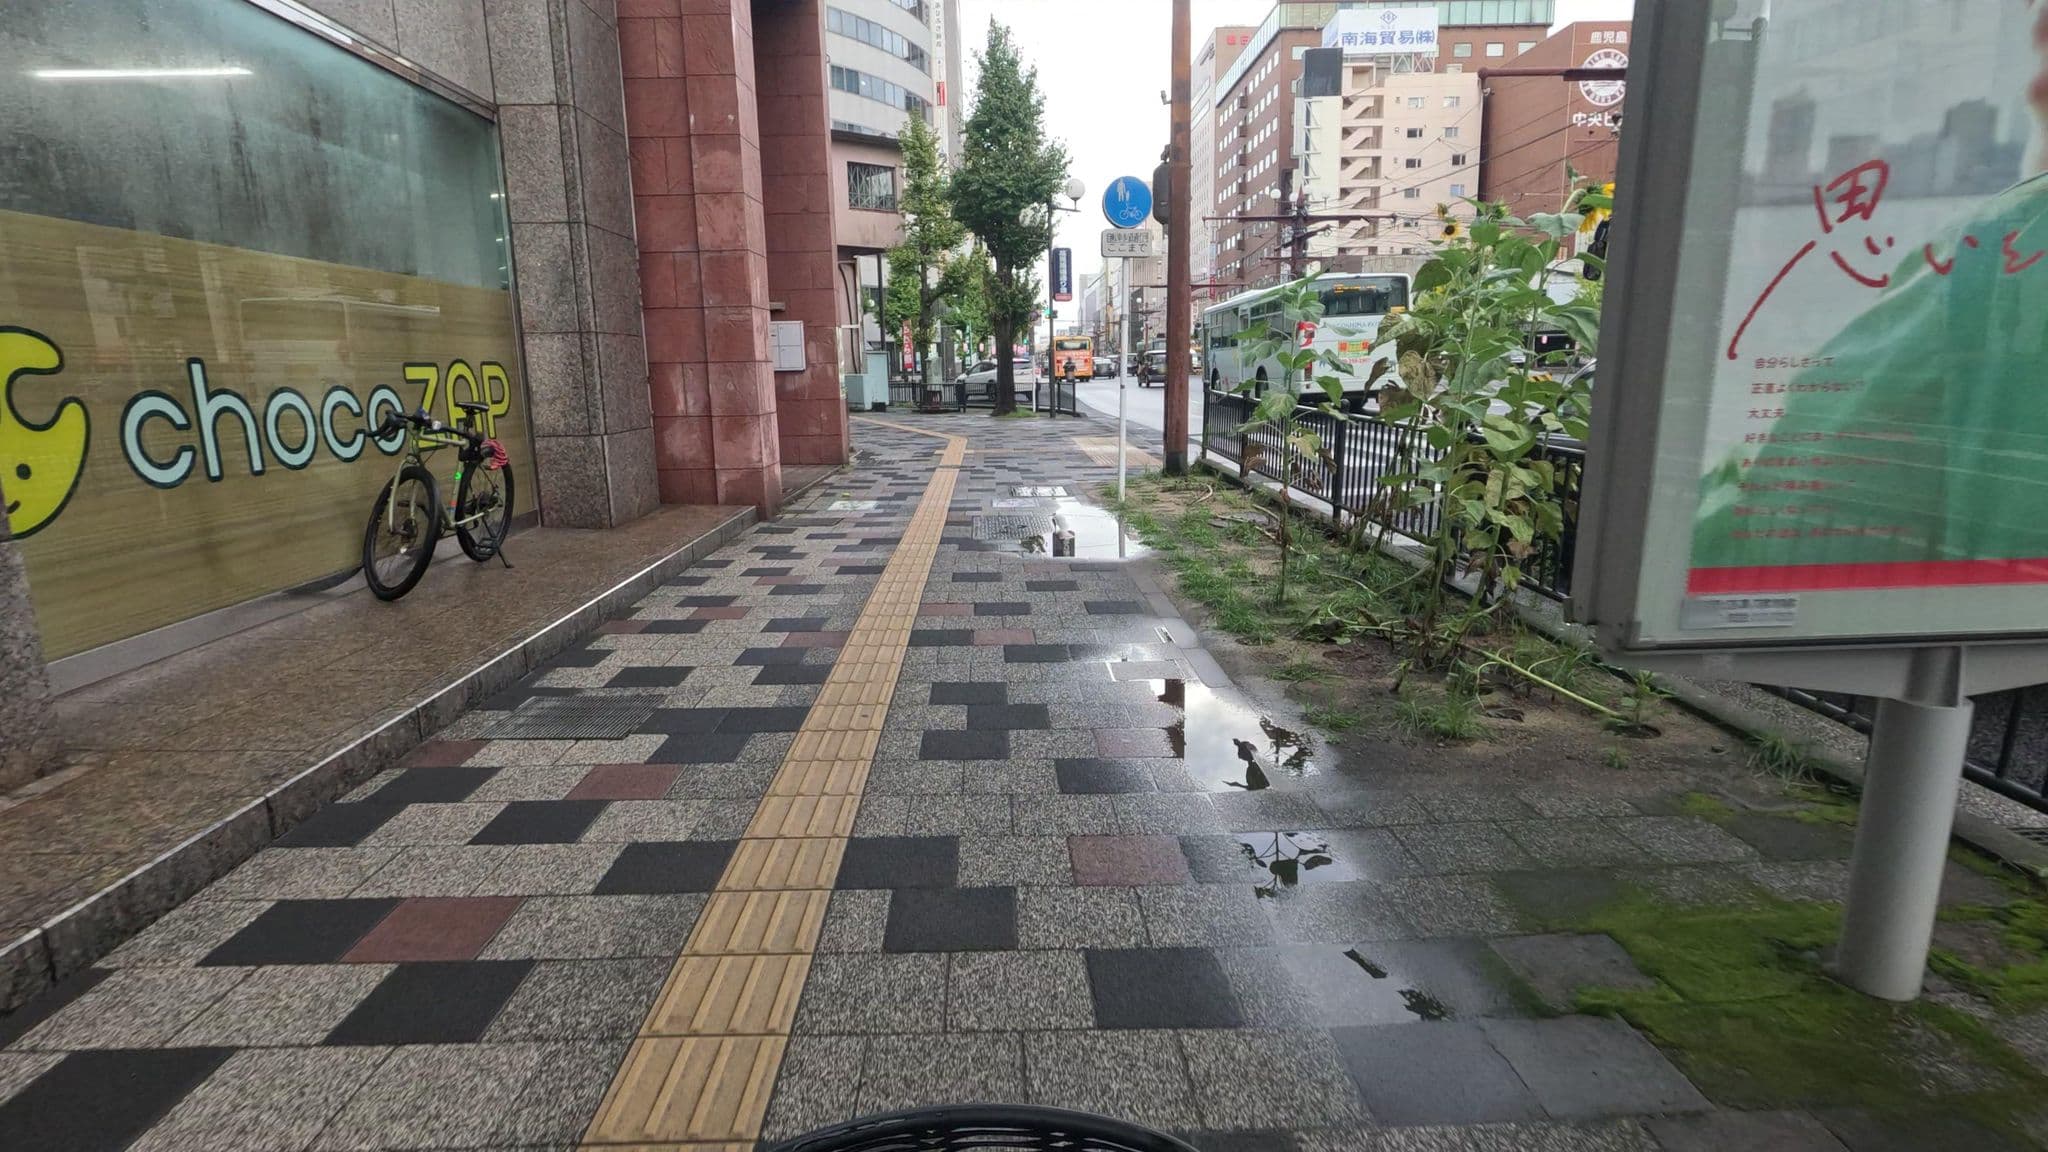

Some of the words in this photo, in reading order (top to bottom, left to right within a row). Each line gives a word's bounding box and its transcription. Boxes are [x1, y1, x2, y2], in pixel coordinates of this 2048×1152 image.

[1572, 111, 1622, 128] 中央ビ
[1107, 243, 1147, 253] ここまで
[1747, 408, 1785, 419] 大丈夫
[120, 357, 511, 489] chocoZAP
